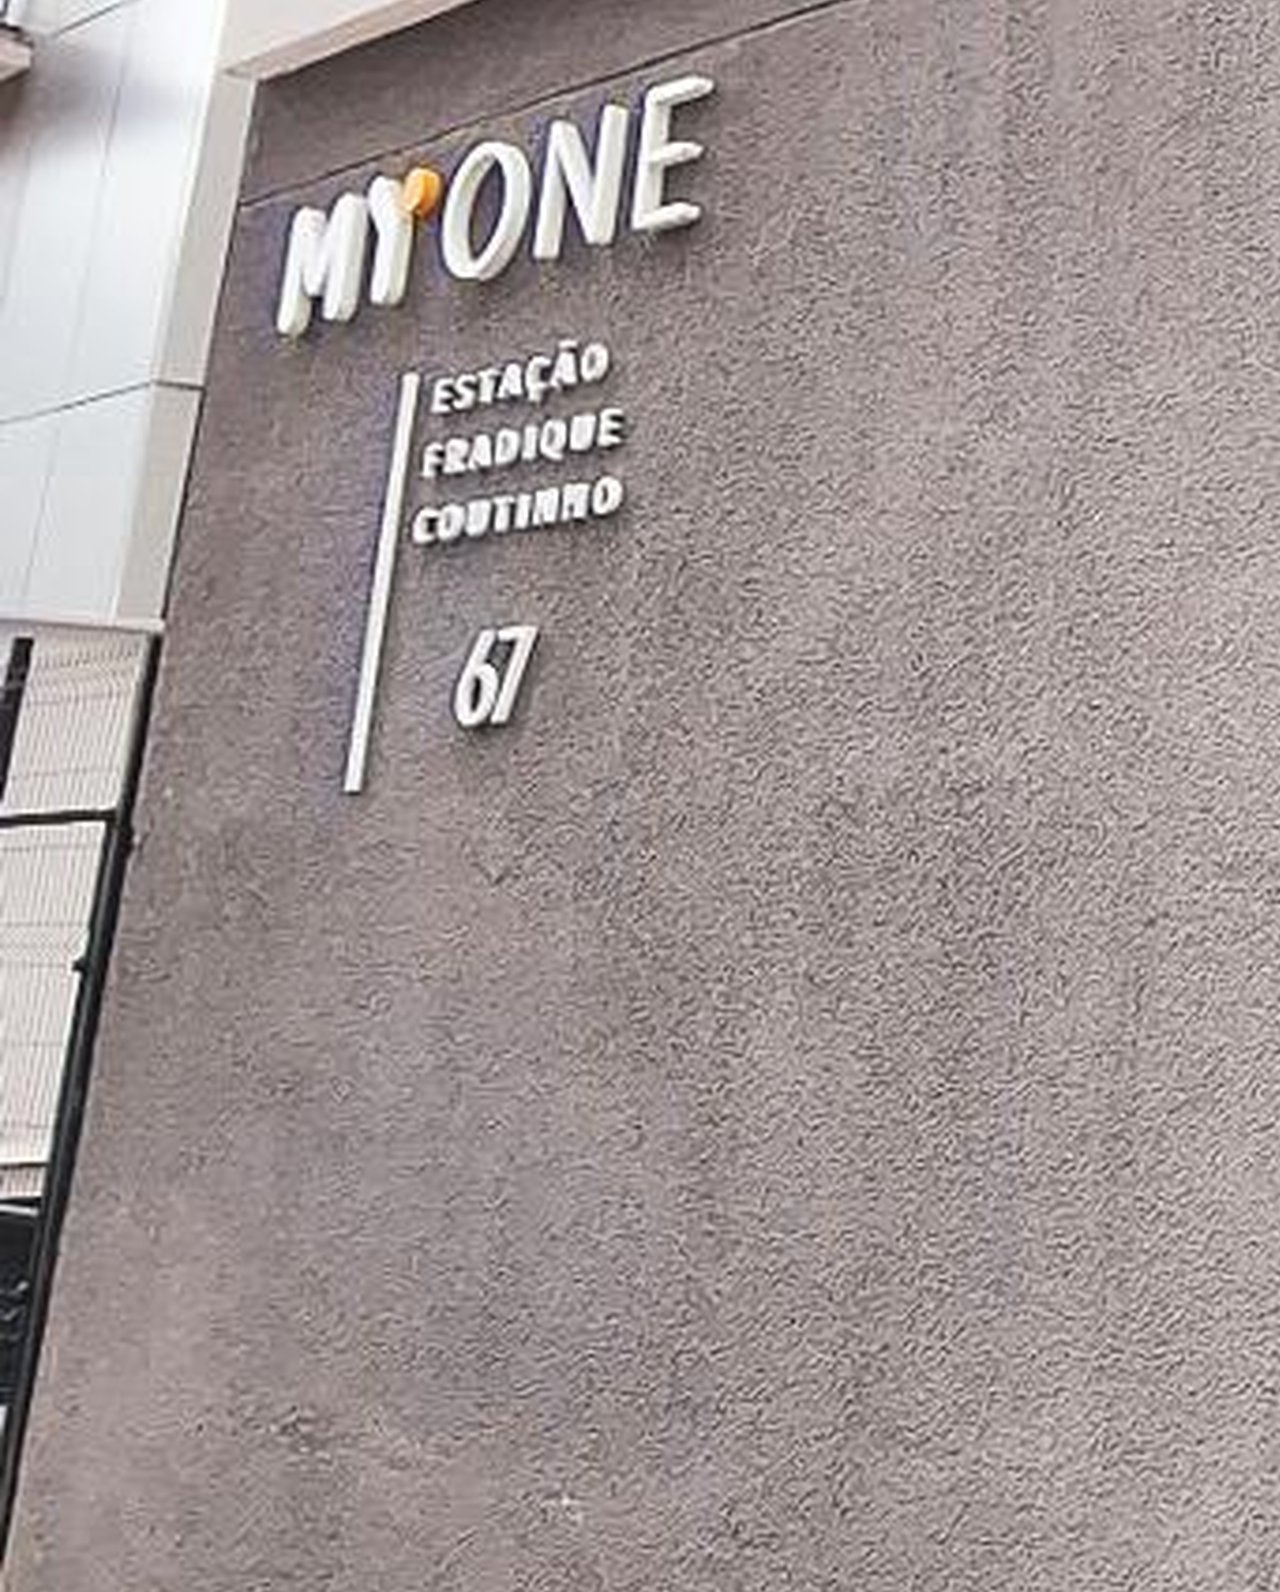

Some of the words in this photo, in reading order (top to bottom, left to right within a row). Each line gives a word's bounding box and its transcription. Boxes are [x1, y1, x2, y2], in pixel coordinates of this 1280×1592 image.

[430, 340, 610, 416] ESTAÇÃO
[421, 408, 625, 480] FRADIQUE
[412, 477, 623, 546] COUTINHO
[454, 626, 537, 728] 67
